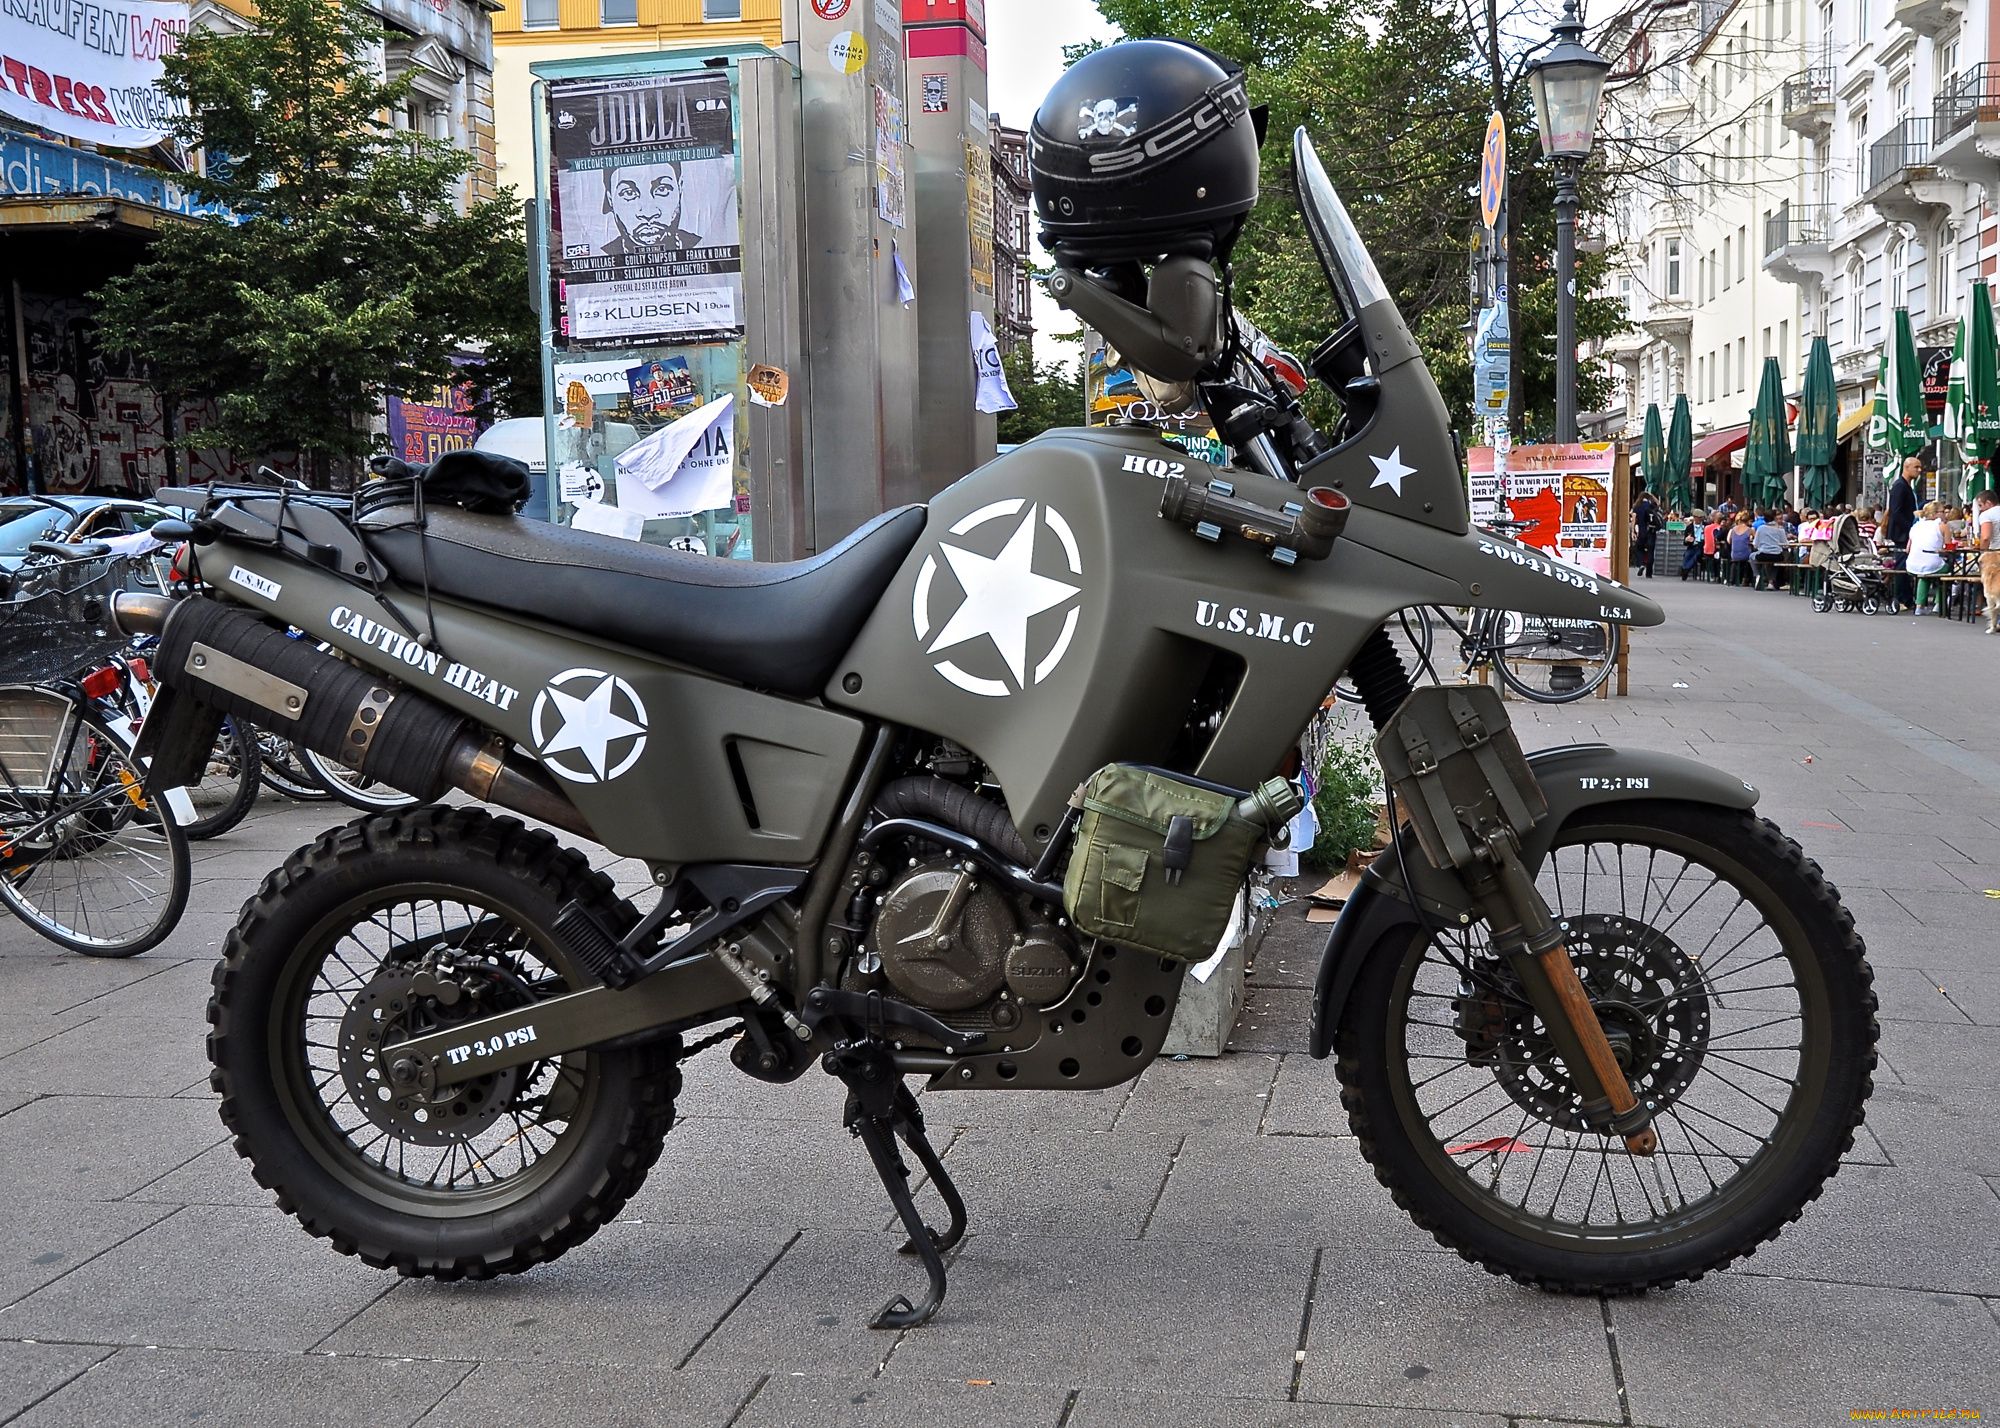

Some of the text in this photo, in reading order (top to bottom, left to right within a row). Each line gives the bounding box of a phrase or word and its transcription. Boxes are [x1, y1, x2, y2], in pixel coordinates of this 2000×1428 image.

[834, 44, 863, 54] ADANA
[0, 54, 115, 125] TRESS
[1088, 83, 1248, 174] SCOT
[574, 158, 604, 171] WELCOME
[605, 157, 612, 167] TO
[614, 154, 646, 167] DILLAVILLE
[652, 153, 657, 162] A
[657, 150, 682, 162] TRIBUTE
[683, 149, 690, 160] TO
[692, 149, 696, 159] J
[571, 247, 732, 270] SLUM VILLAGE GUILTY SIMPSON FRANK N DANK
[595, 271, 609, 282] ILLA
[610, 271, 615, 280] J
[624, 267, 655, 280] SLIMKID3
[613, 282, 634, 293] SPECIAL
[634, 282, 640, 291] DJ
[641, 281, 651, 291] SET
[651, 280, 658, 290] BY
[658, 280, 668, 289] CEE
[669, 279, 688, 288] BROWN
[605, 301, 700, 321] KLUBSEN
[405, 432, 425, 456] 23
[690, 460, 713, 469] OHNE
[716, 457, 729, 466] UNS
[1121, 454, 1186, 479] HQ2
[1471, 488, 1487, 496] IHR
[1516, 487, 1534, 495] UNS
[234, 569, 276, 595] U.S.M.C
[1600, 605, 1632, 619] U.S.A
[1195, 600, 1315, 647] U.S.M.C
[329, 605, 519, 712] CAUTION HEAT
[1580, 777, 1649, 791] TP 2,7 PSI
[1011, 966, 1066, 977] SUZUKI
[447, 1025, 537, 1065] TP 3,0 PSI
